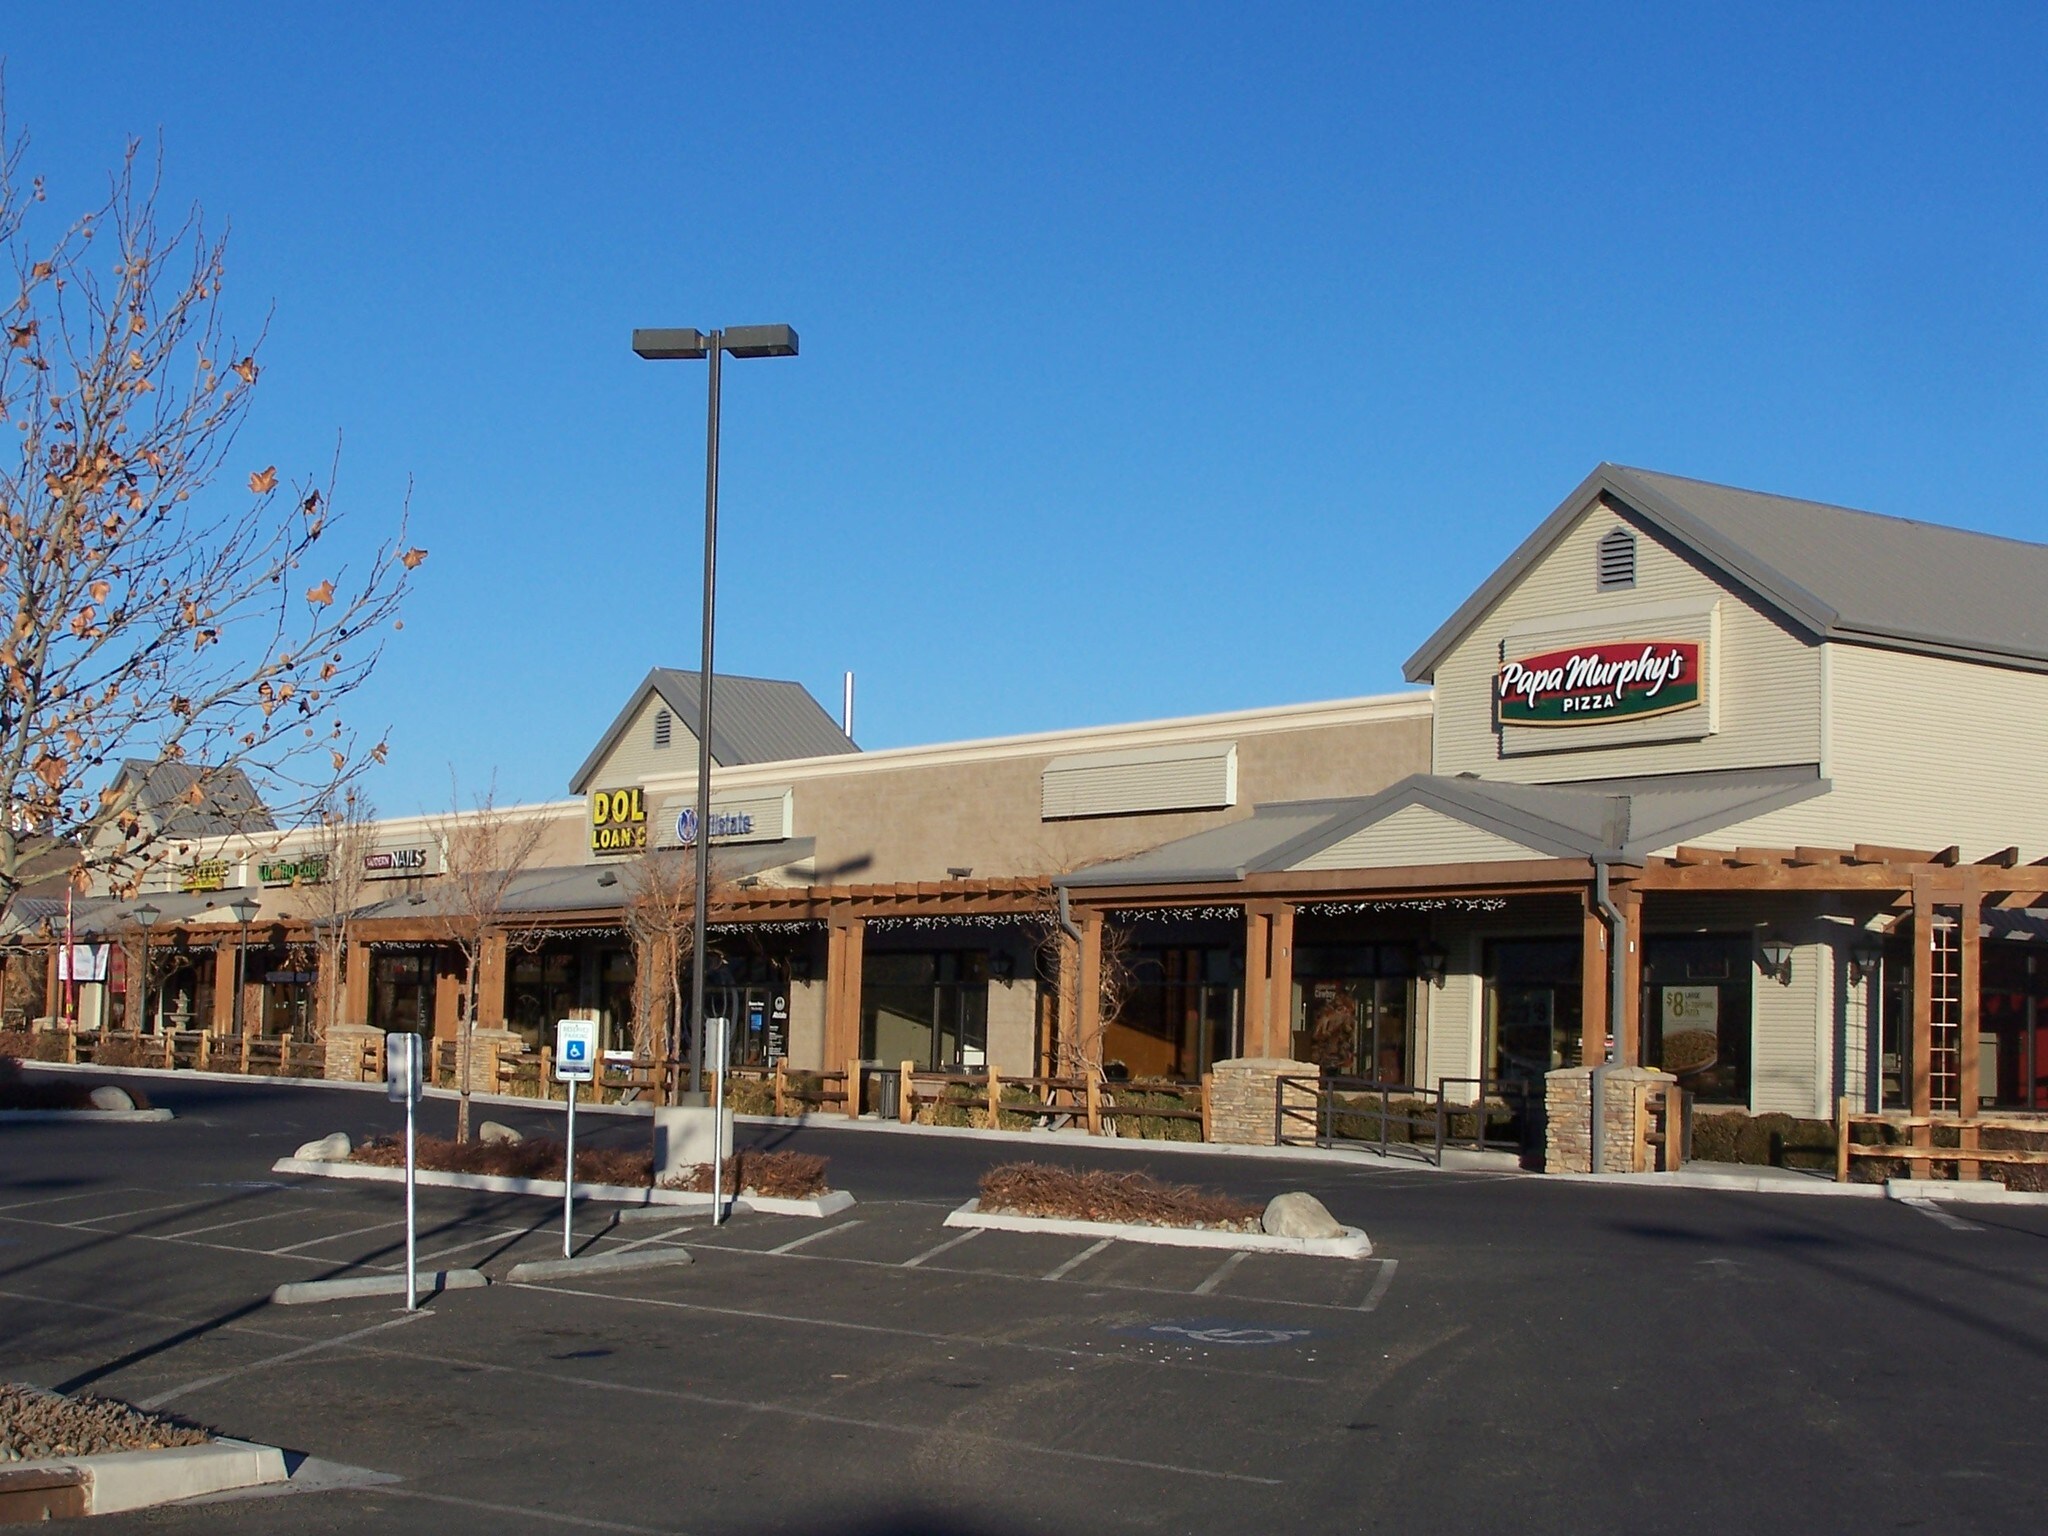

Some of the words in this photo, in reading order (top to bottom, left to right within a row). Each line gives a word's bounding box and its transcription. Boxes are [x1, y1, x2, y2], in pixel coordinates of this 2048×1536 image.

[1501, 662, 1563, 708] Papa
[1564, 646, 1684, 699] Murphy's
[1563, 693, 1614, 712] PIZZA
[594, 788, 645, 825] DOL
[708, 813, 752, 837] llstate
[591, 827, 631, 849] LOAN
[391, 849, 423, 867] NAILS
[257, 860, 294, 885] Cuing
